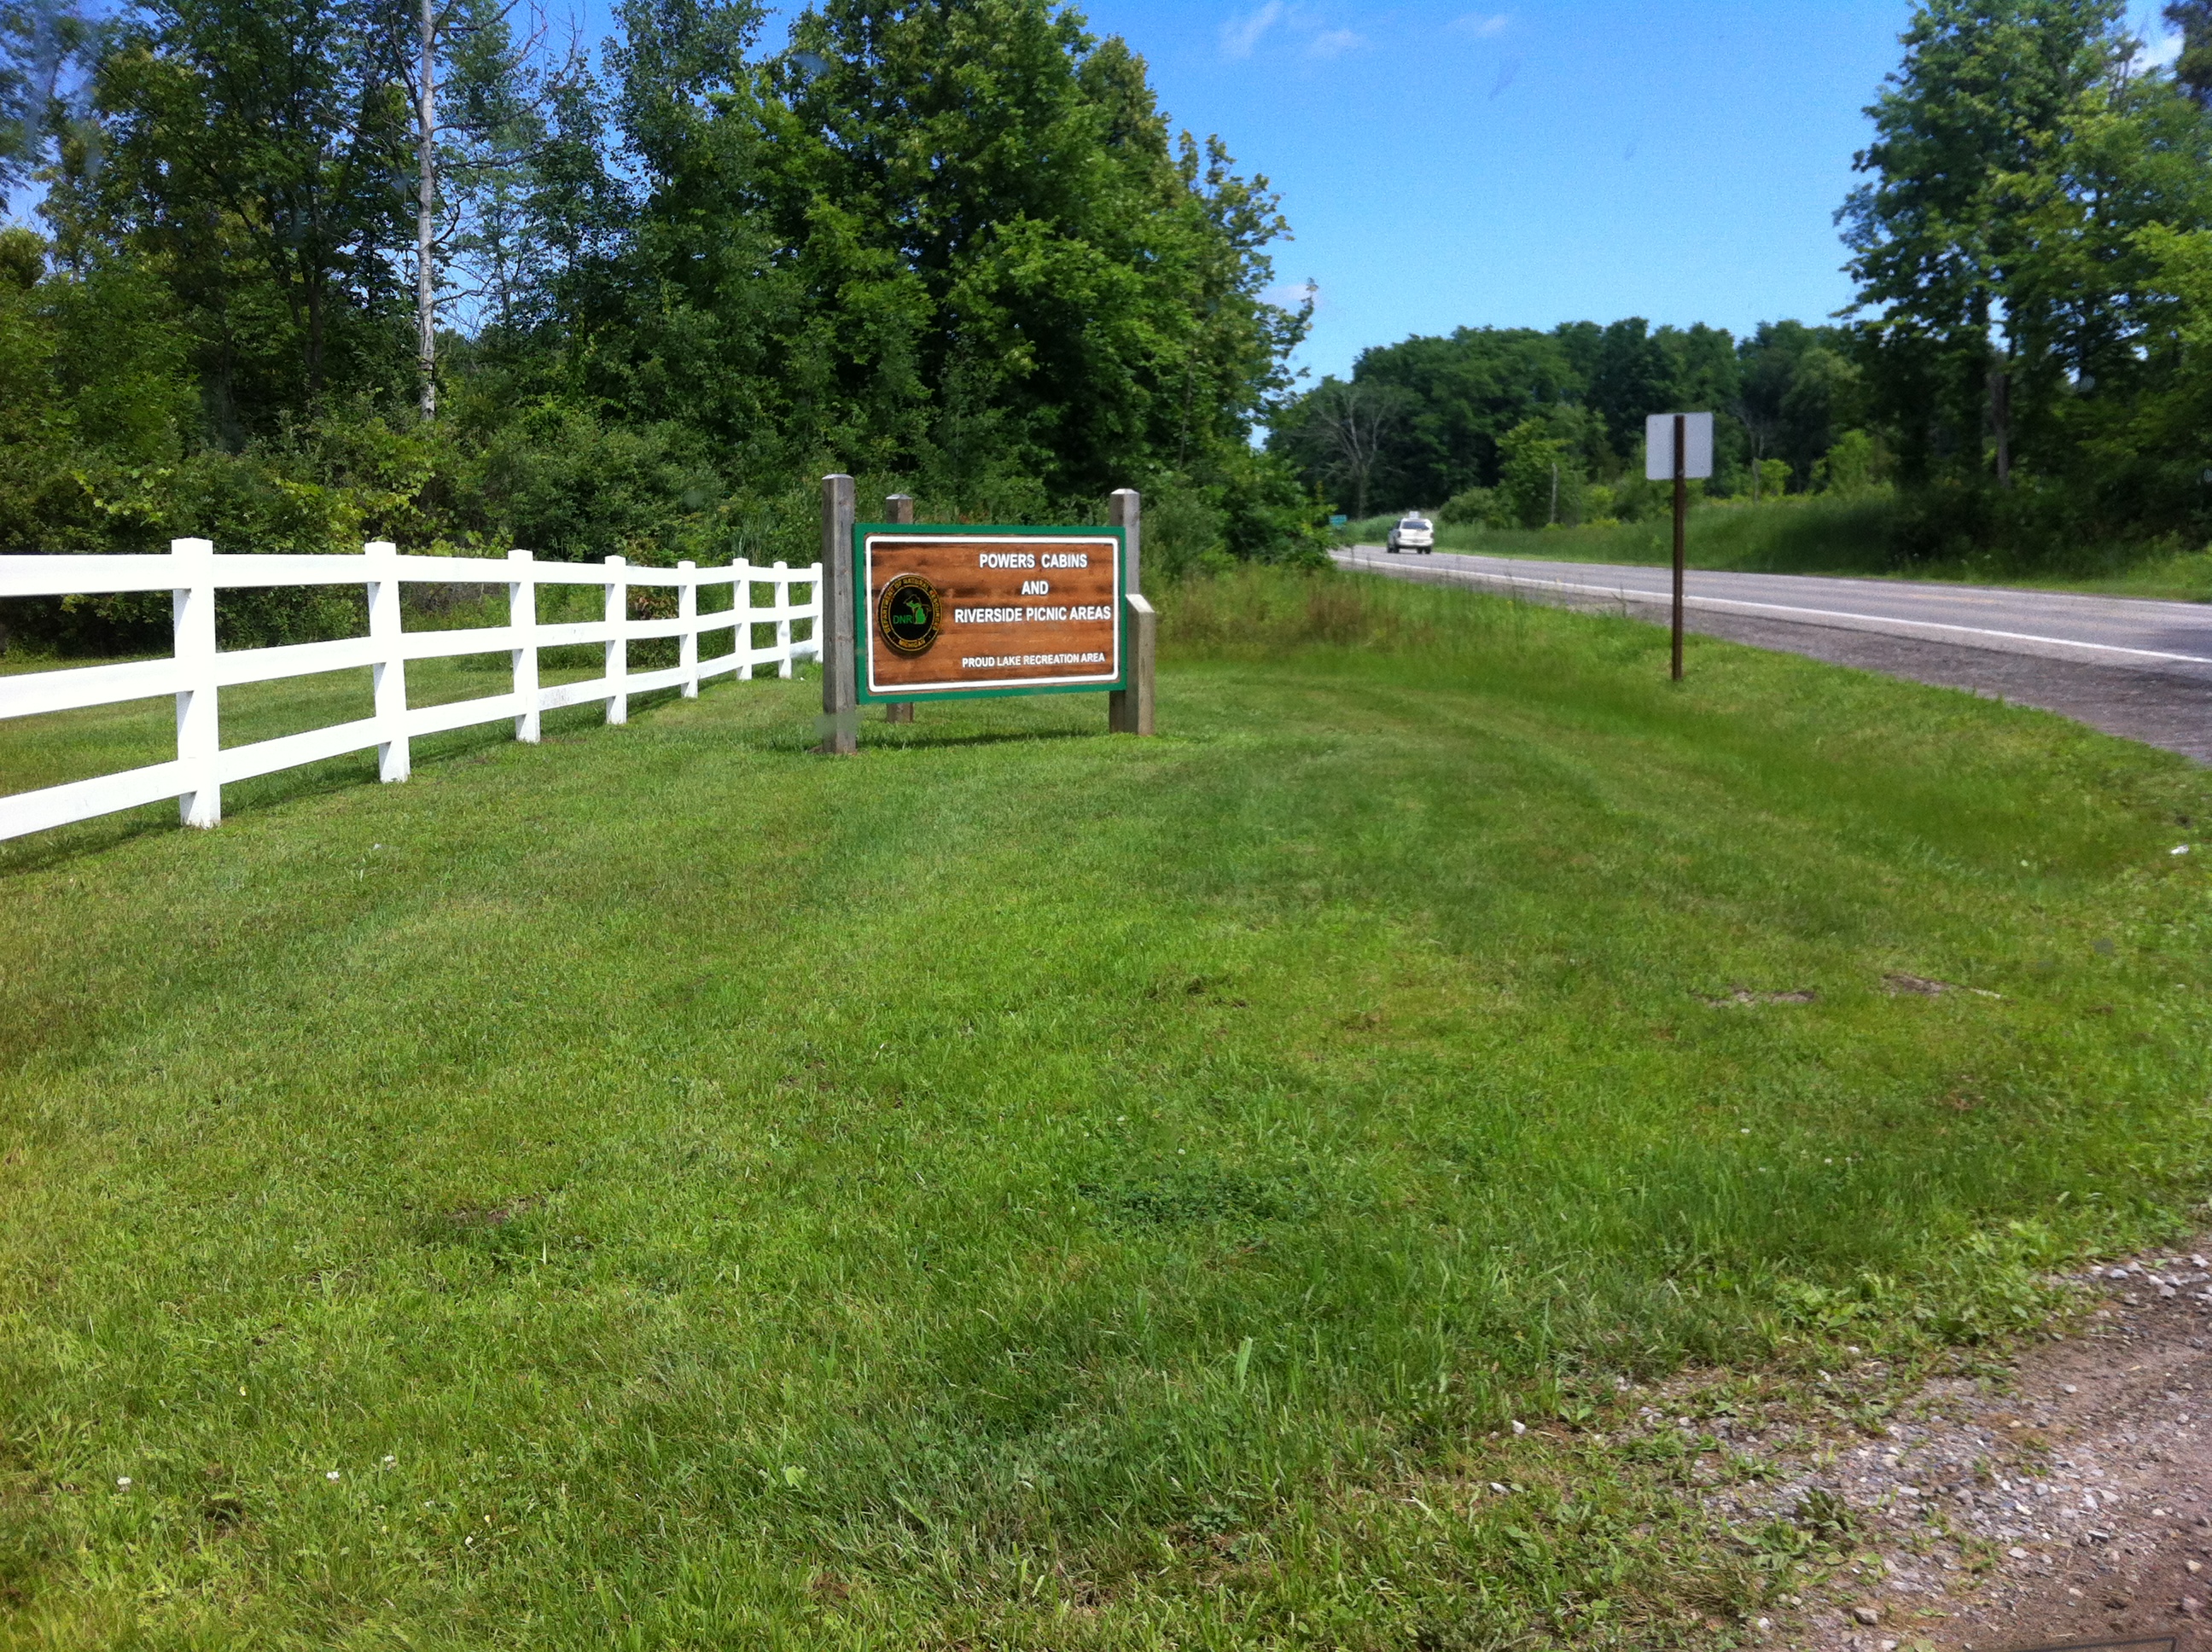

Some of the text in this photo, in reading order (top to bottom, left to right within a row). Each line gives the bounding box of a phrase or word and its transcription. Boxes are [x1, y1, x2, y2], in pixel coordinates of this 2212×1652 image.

[979, 553, 1088, 568] POWERS CABINS
[903, 578, 929, 590] NATURAL
[1021, 580, 1050, 595] AND
[893, 614, 913, 625] DNR
[954, 606, 1112, 623] RIVERSIDE PICNIC AREAS
[962, 653, 1106, 668] PROUD LAKE RECREATION AREA
